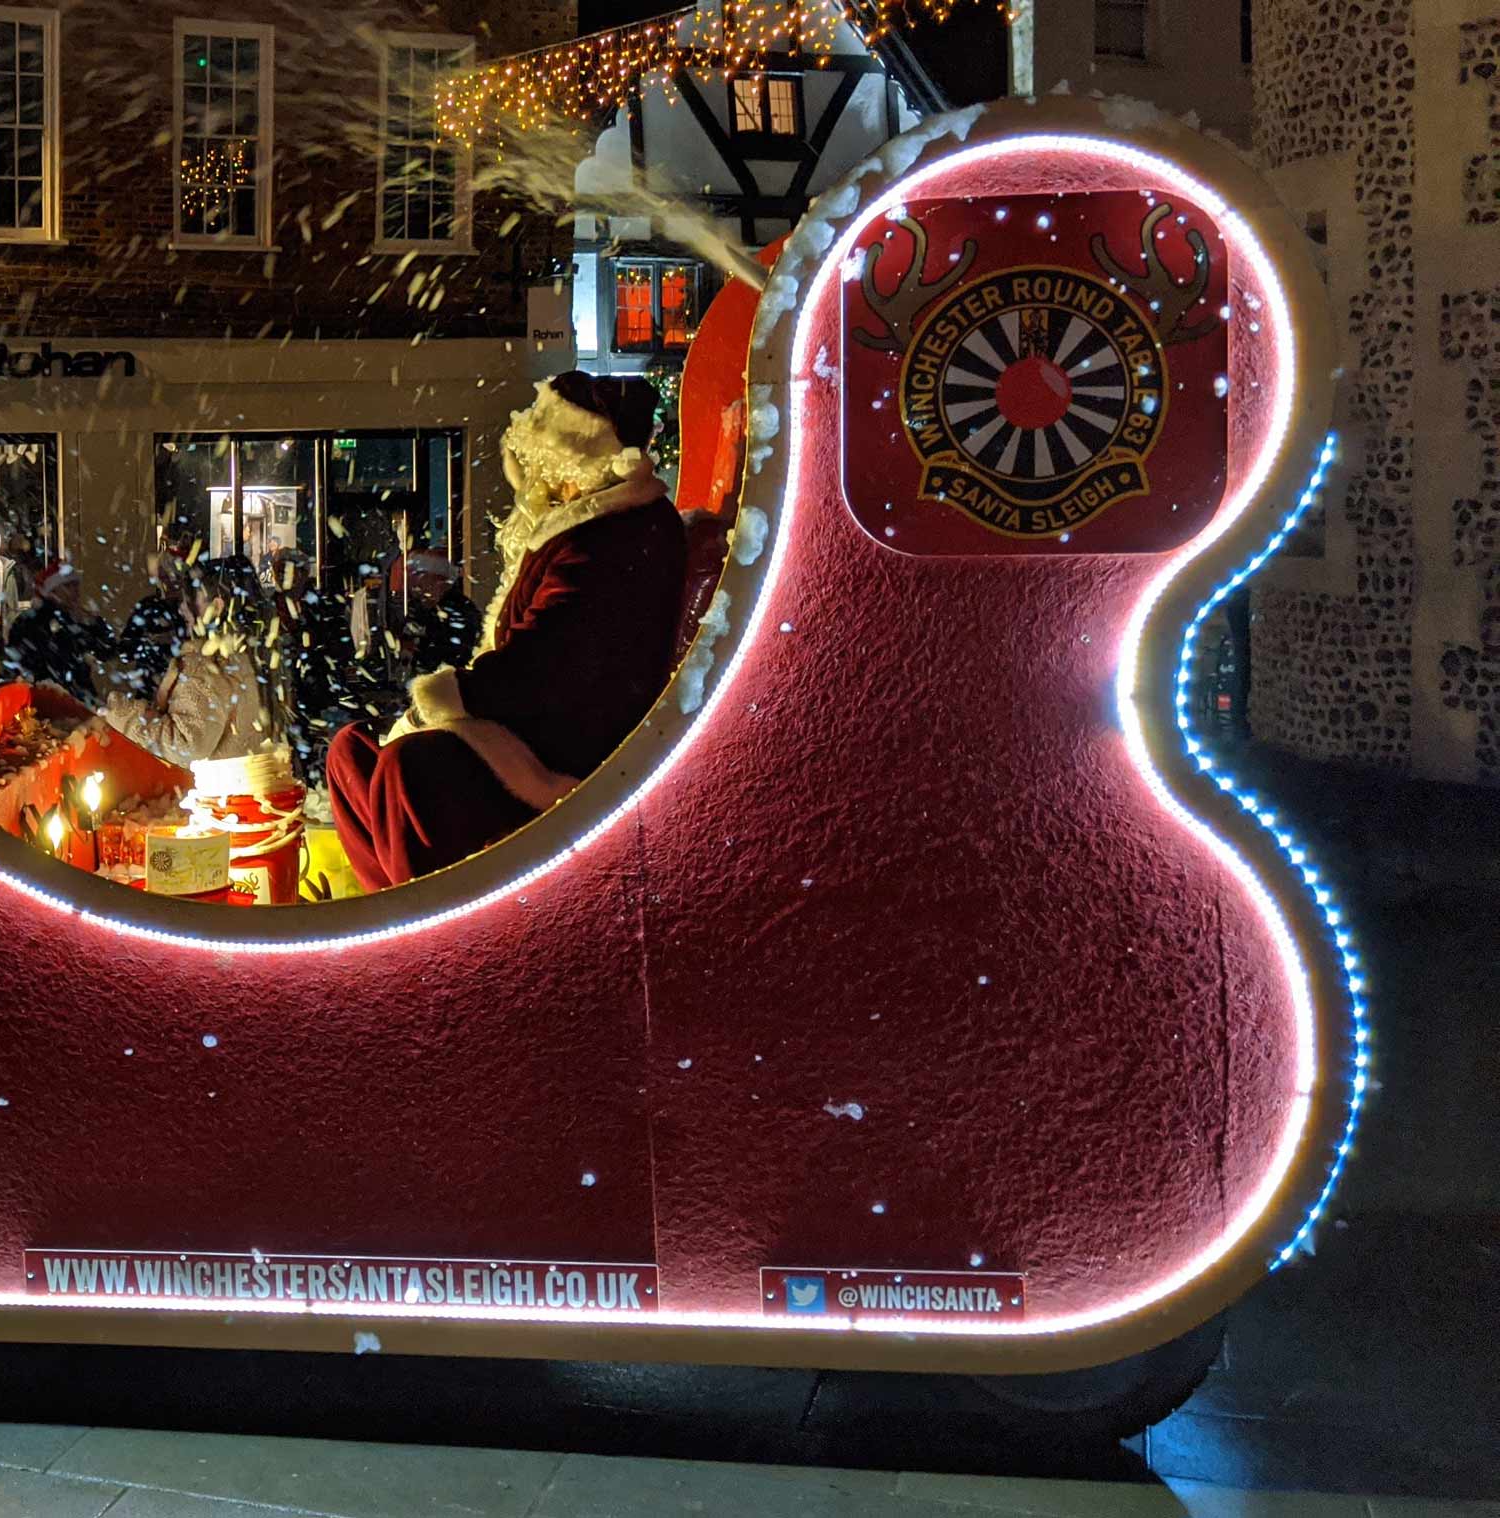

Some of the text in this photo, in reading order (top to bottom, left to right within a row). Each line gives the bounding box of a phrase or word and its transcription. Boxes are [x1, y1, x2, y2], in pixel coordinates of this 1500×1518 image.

[532, 329, 564, 339] Rohan
[911, 277, 1158, 448] WINCHESTER ROUND TABLE 63
[950, 476, 1116, 530] SANTA SLEIGH
[43, 1257, 641, 1309] WWW.WINCHESTERSANTASLEIGH.CO.UK
[837, 1284, 1001, 1312] @WINCHSANTA
